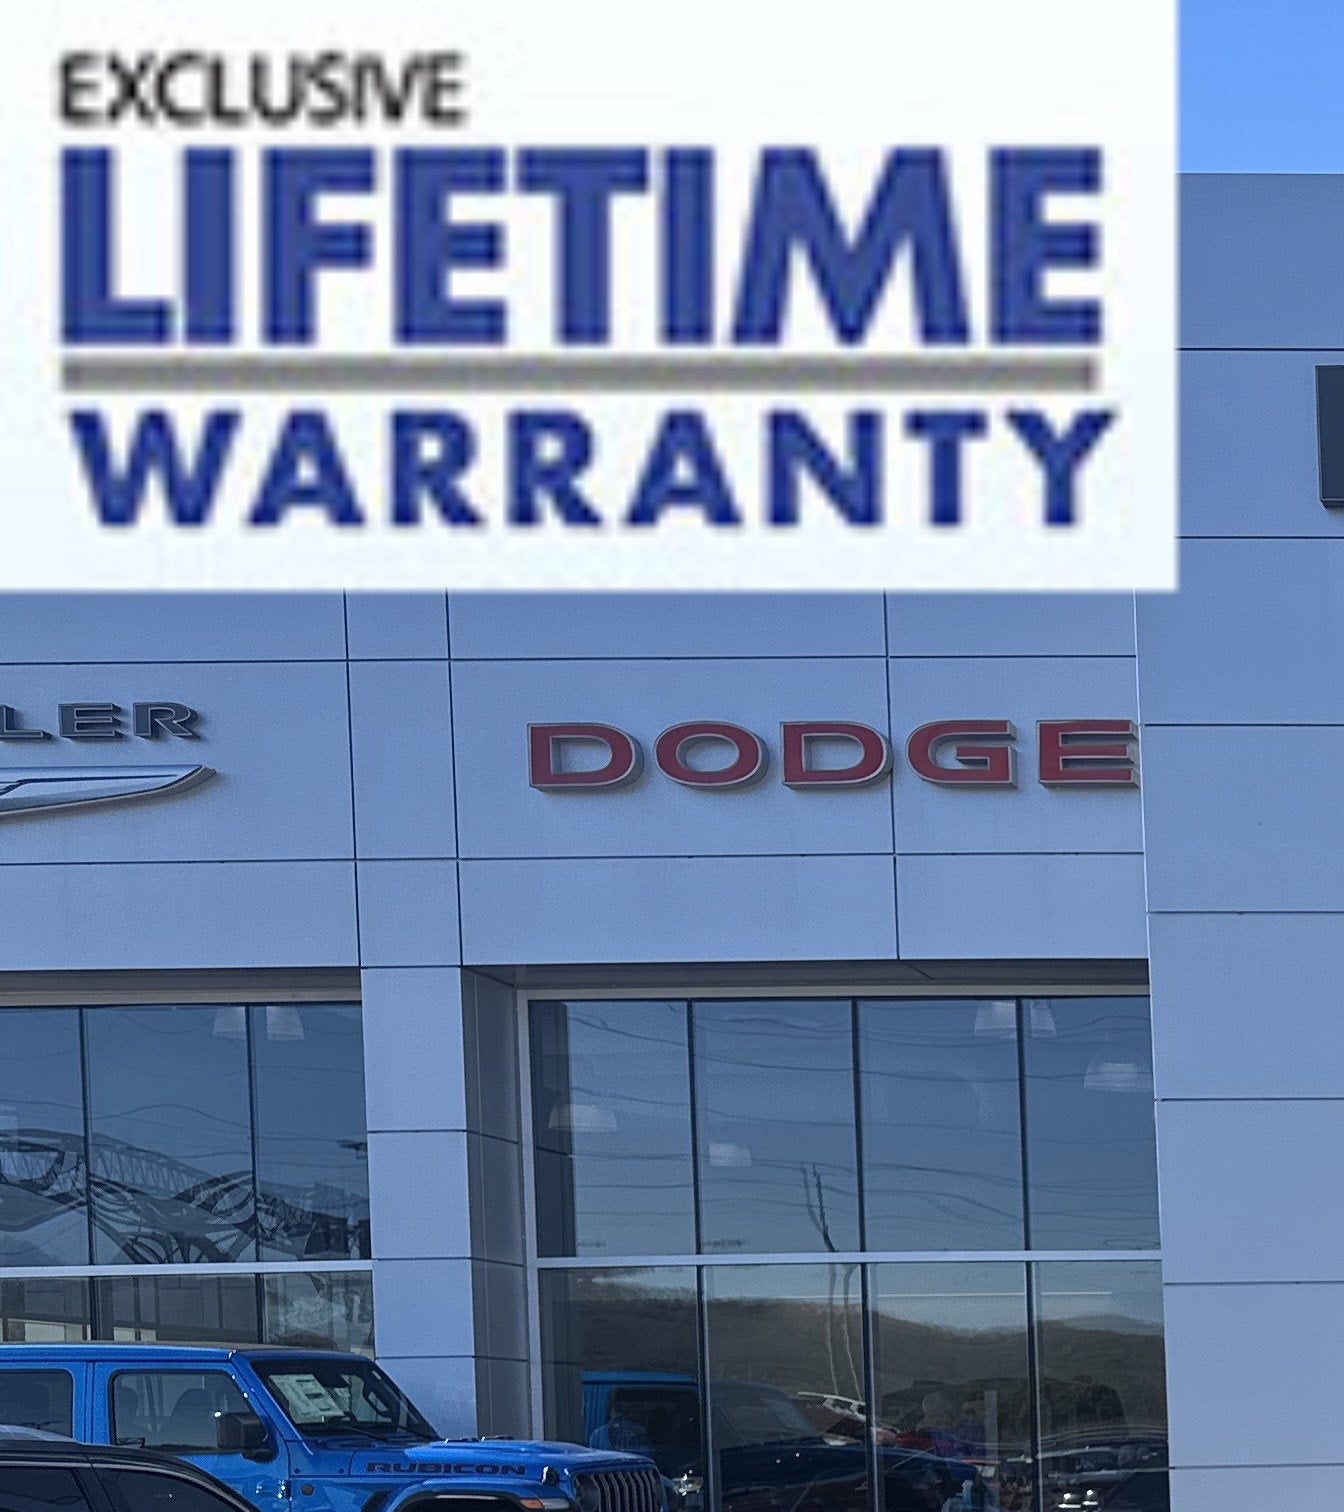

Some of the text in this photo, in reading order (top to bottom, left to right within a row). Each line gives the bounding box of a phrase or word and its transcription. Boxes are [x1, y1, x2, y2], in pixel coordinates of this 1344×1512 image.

[0, 702, 198, 739] LER
[526, 719, 1140, 790] DODGE
[365, 1462, 527, 1476] RUBICON
